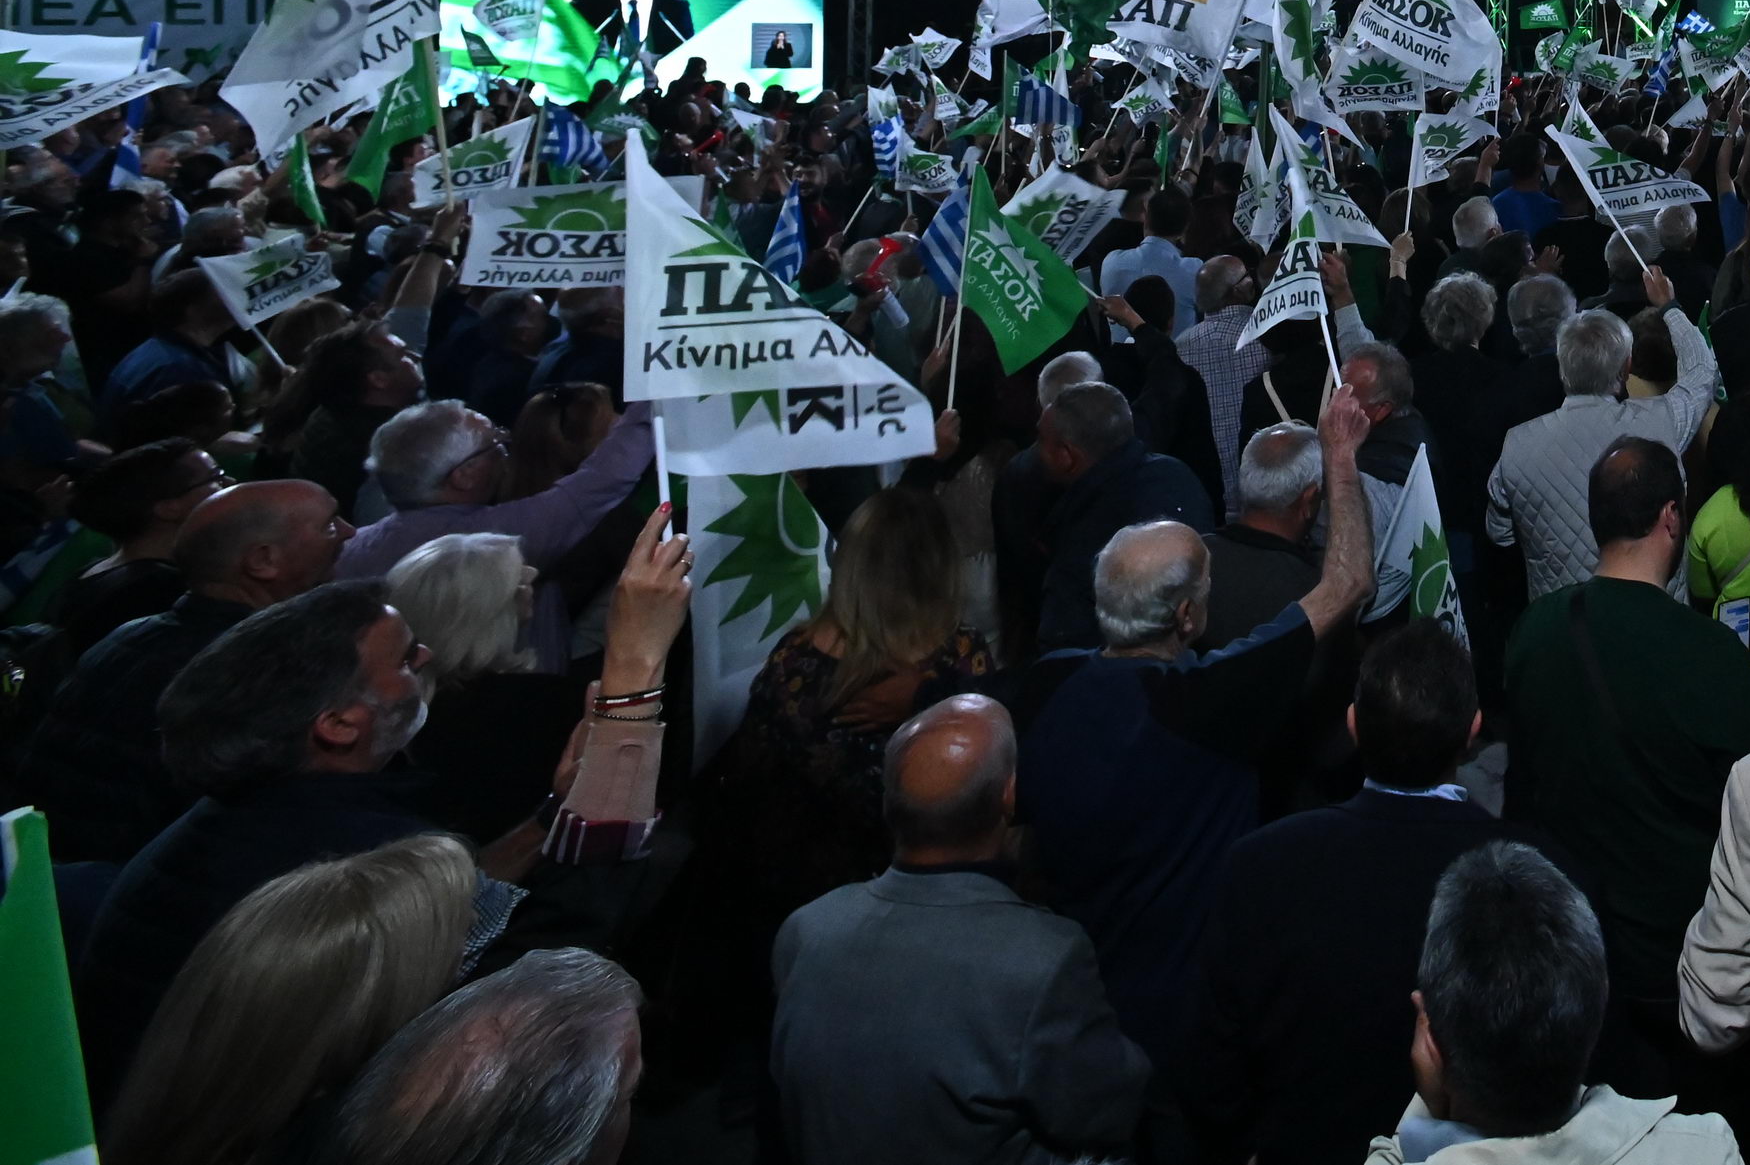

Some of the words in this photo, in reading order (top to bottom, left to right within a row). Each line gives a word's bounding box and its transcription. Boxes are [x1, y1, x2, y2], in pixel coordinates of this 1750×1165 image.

[1359, 10, 1389, 39] Κίνημα
[1391, 32, 1450, 67] Αλλαγής
[1643, 185, 1702, 204] Αλλαγής
[660, 262, 812, 317] ΠΑ
[978, 282, 1021, 340] Αλλαγής
[643, 335, 794, 373] Κίνημα
